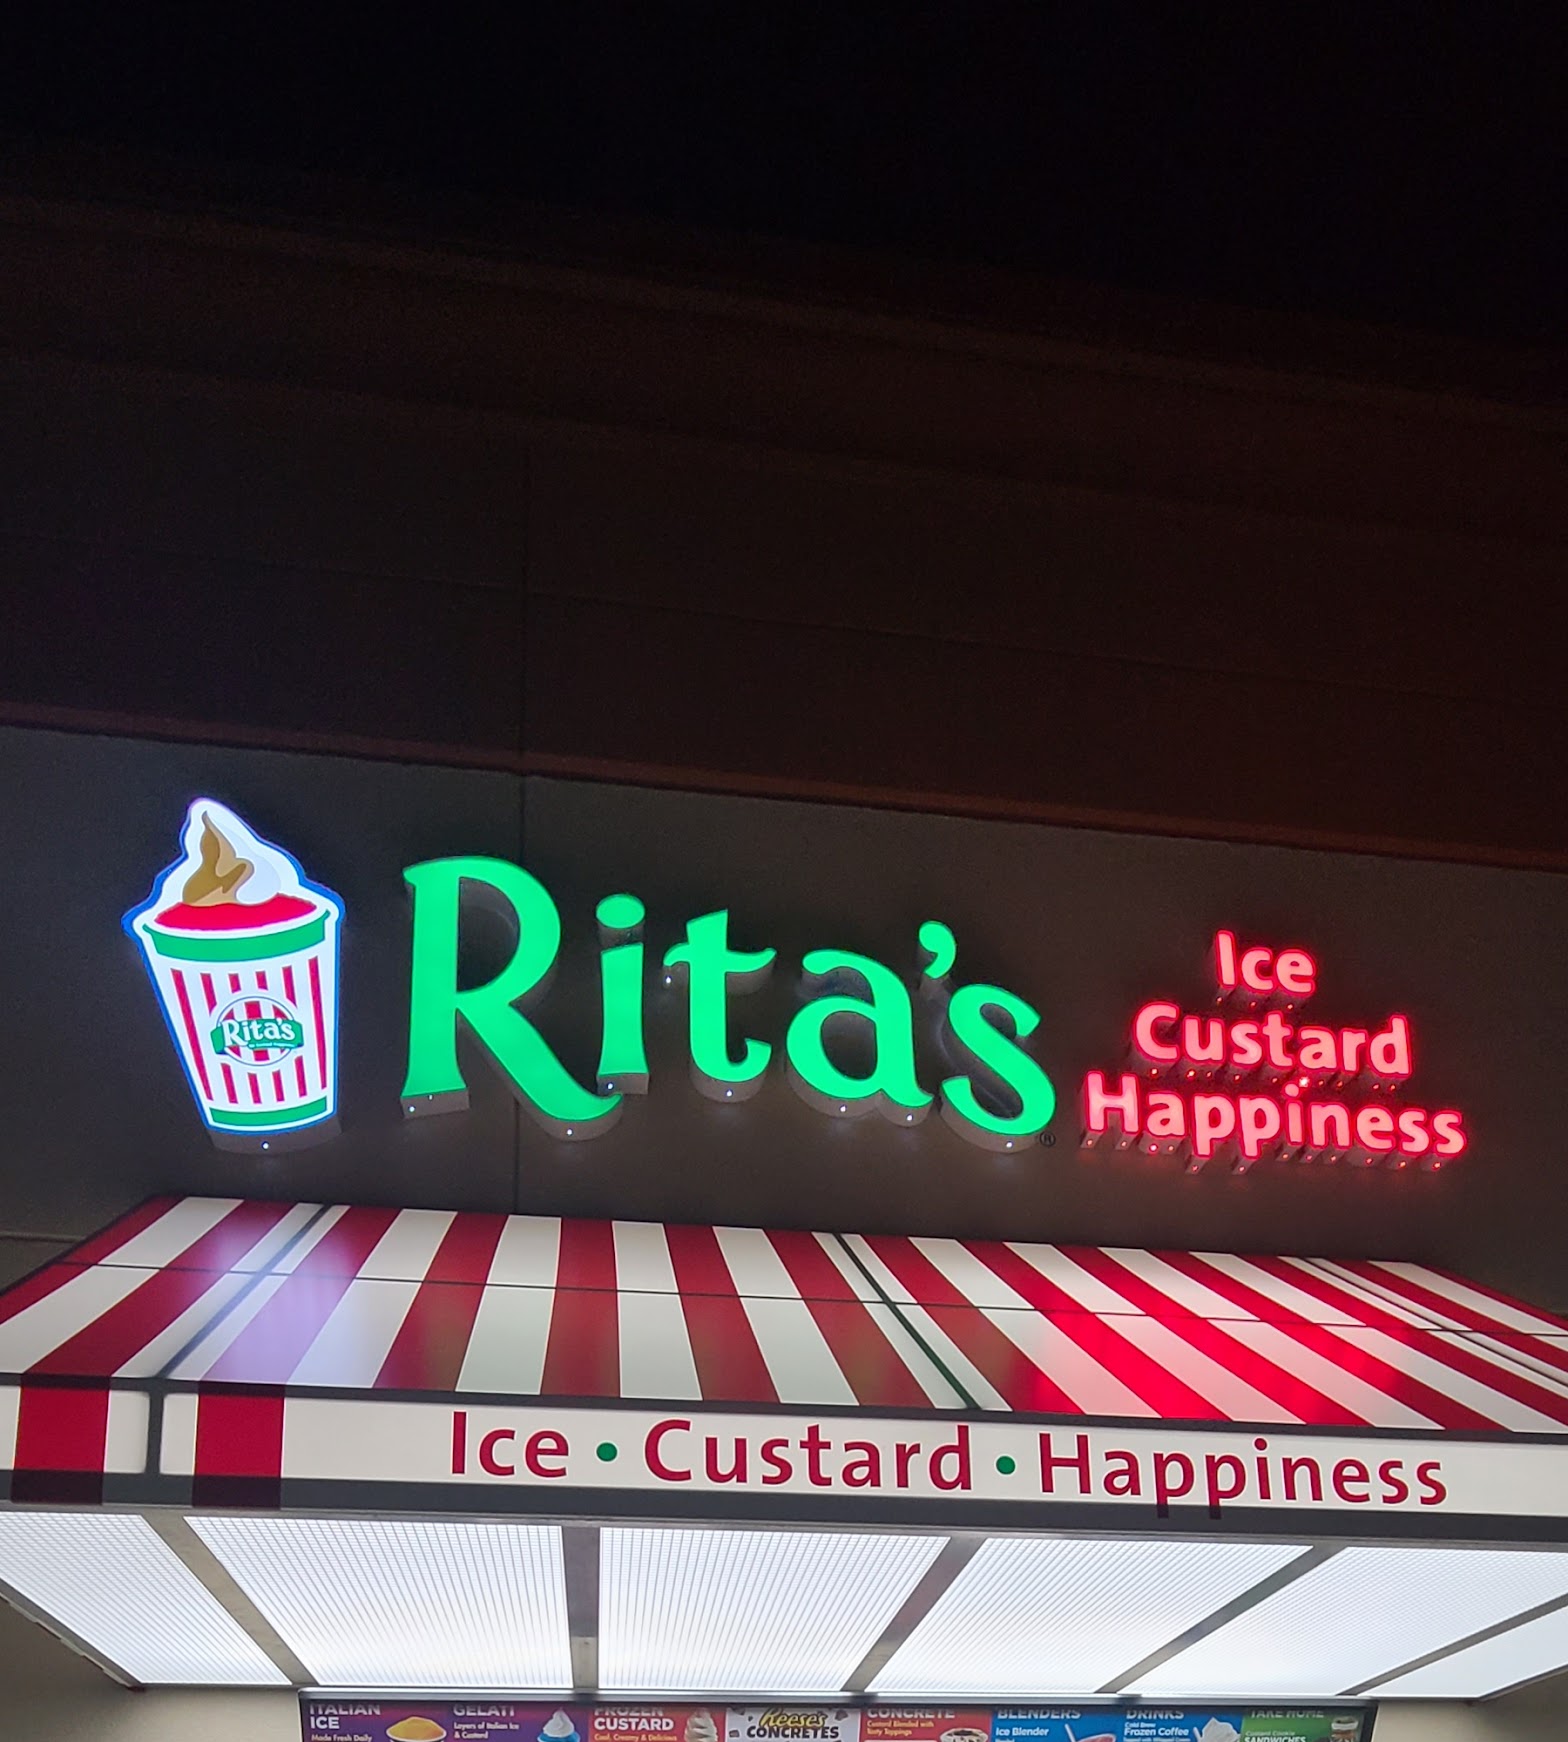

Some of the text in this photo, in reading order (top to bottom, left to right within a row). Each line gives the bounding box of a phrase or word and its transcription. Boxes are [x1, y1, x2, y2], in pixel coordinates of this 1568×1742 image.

[1215, 929, 1318, 994] Ice
[402, 856, 1056, 1139] Rita's
[221, 1017, 296, 1047] Rita's
[1132, 1001, 1413, 1080] Custard
[1084, 1070, 1468, 1160] Happiness
[451, 1410, 1448, 1519] Ice Custard Happiness
[309, 1703, 381, 1715] ITALIAN
[453, 1704, 515, 1717] GELATI
[866, 1708, 956, 1719] CONCRETE
[997, 1709, 1081, 1719] BLENDERS
[310, 1716, 340, 1729] ICE
[594, 1718, 674, 1731] CUSTARD
[332, 1734, 352, 1742] Fresh
[747, 1725, 840, 1739] CONCRETES
[995, 1727, 1049, 1736] Ice Blender
[1124, 1727, 1189, 1737] Frozen Coffee
